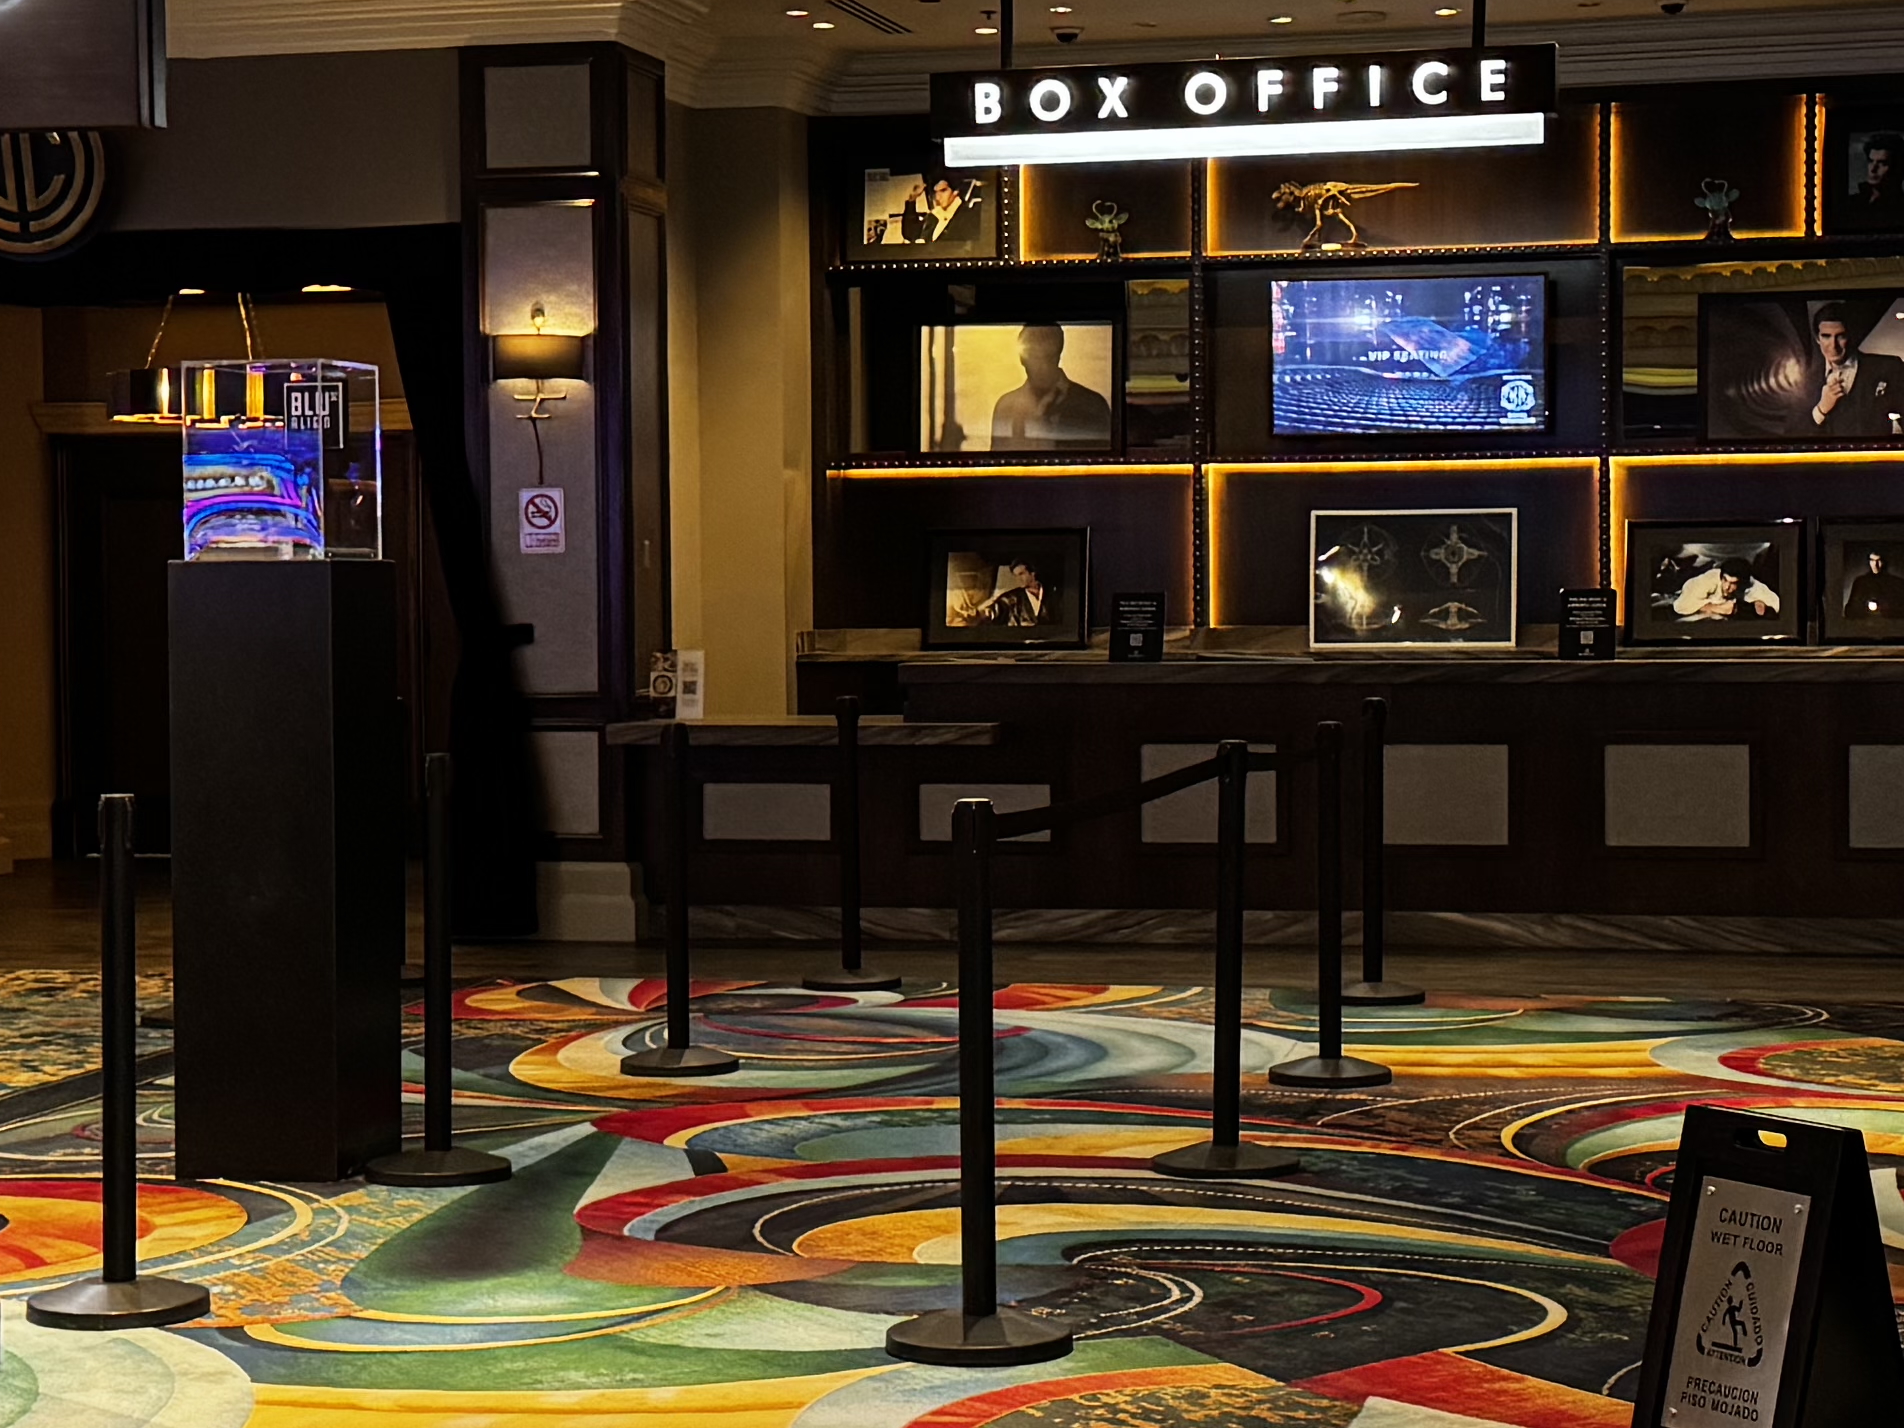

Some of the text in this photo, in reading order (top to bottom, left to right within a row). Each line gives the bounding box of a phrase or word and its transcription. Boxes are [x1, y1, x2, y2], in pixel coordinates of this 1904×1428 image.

[973, 58, 1507, 125] BOX OFFICE
[1719, 1207, 1783, 1234] CAUTION
[1711, 1230, 1784, 1256] WET FLOOR
[1701, 1279, 1733, 1334] CAUTION
[1746, 1279, 1764, 1346] CUIDADO
[1686, 1375, 1760, 1405] PRECAUCION
[1680, 1391, 1759, 1422] PISO MOJADO
